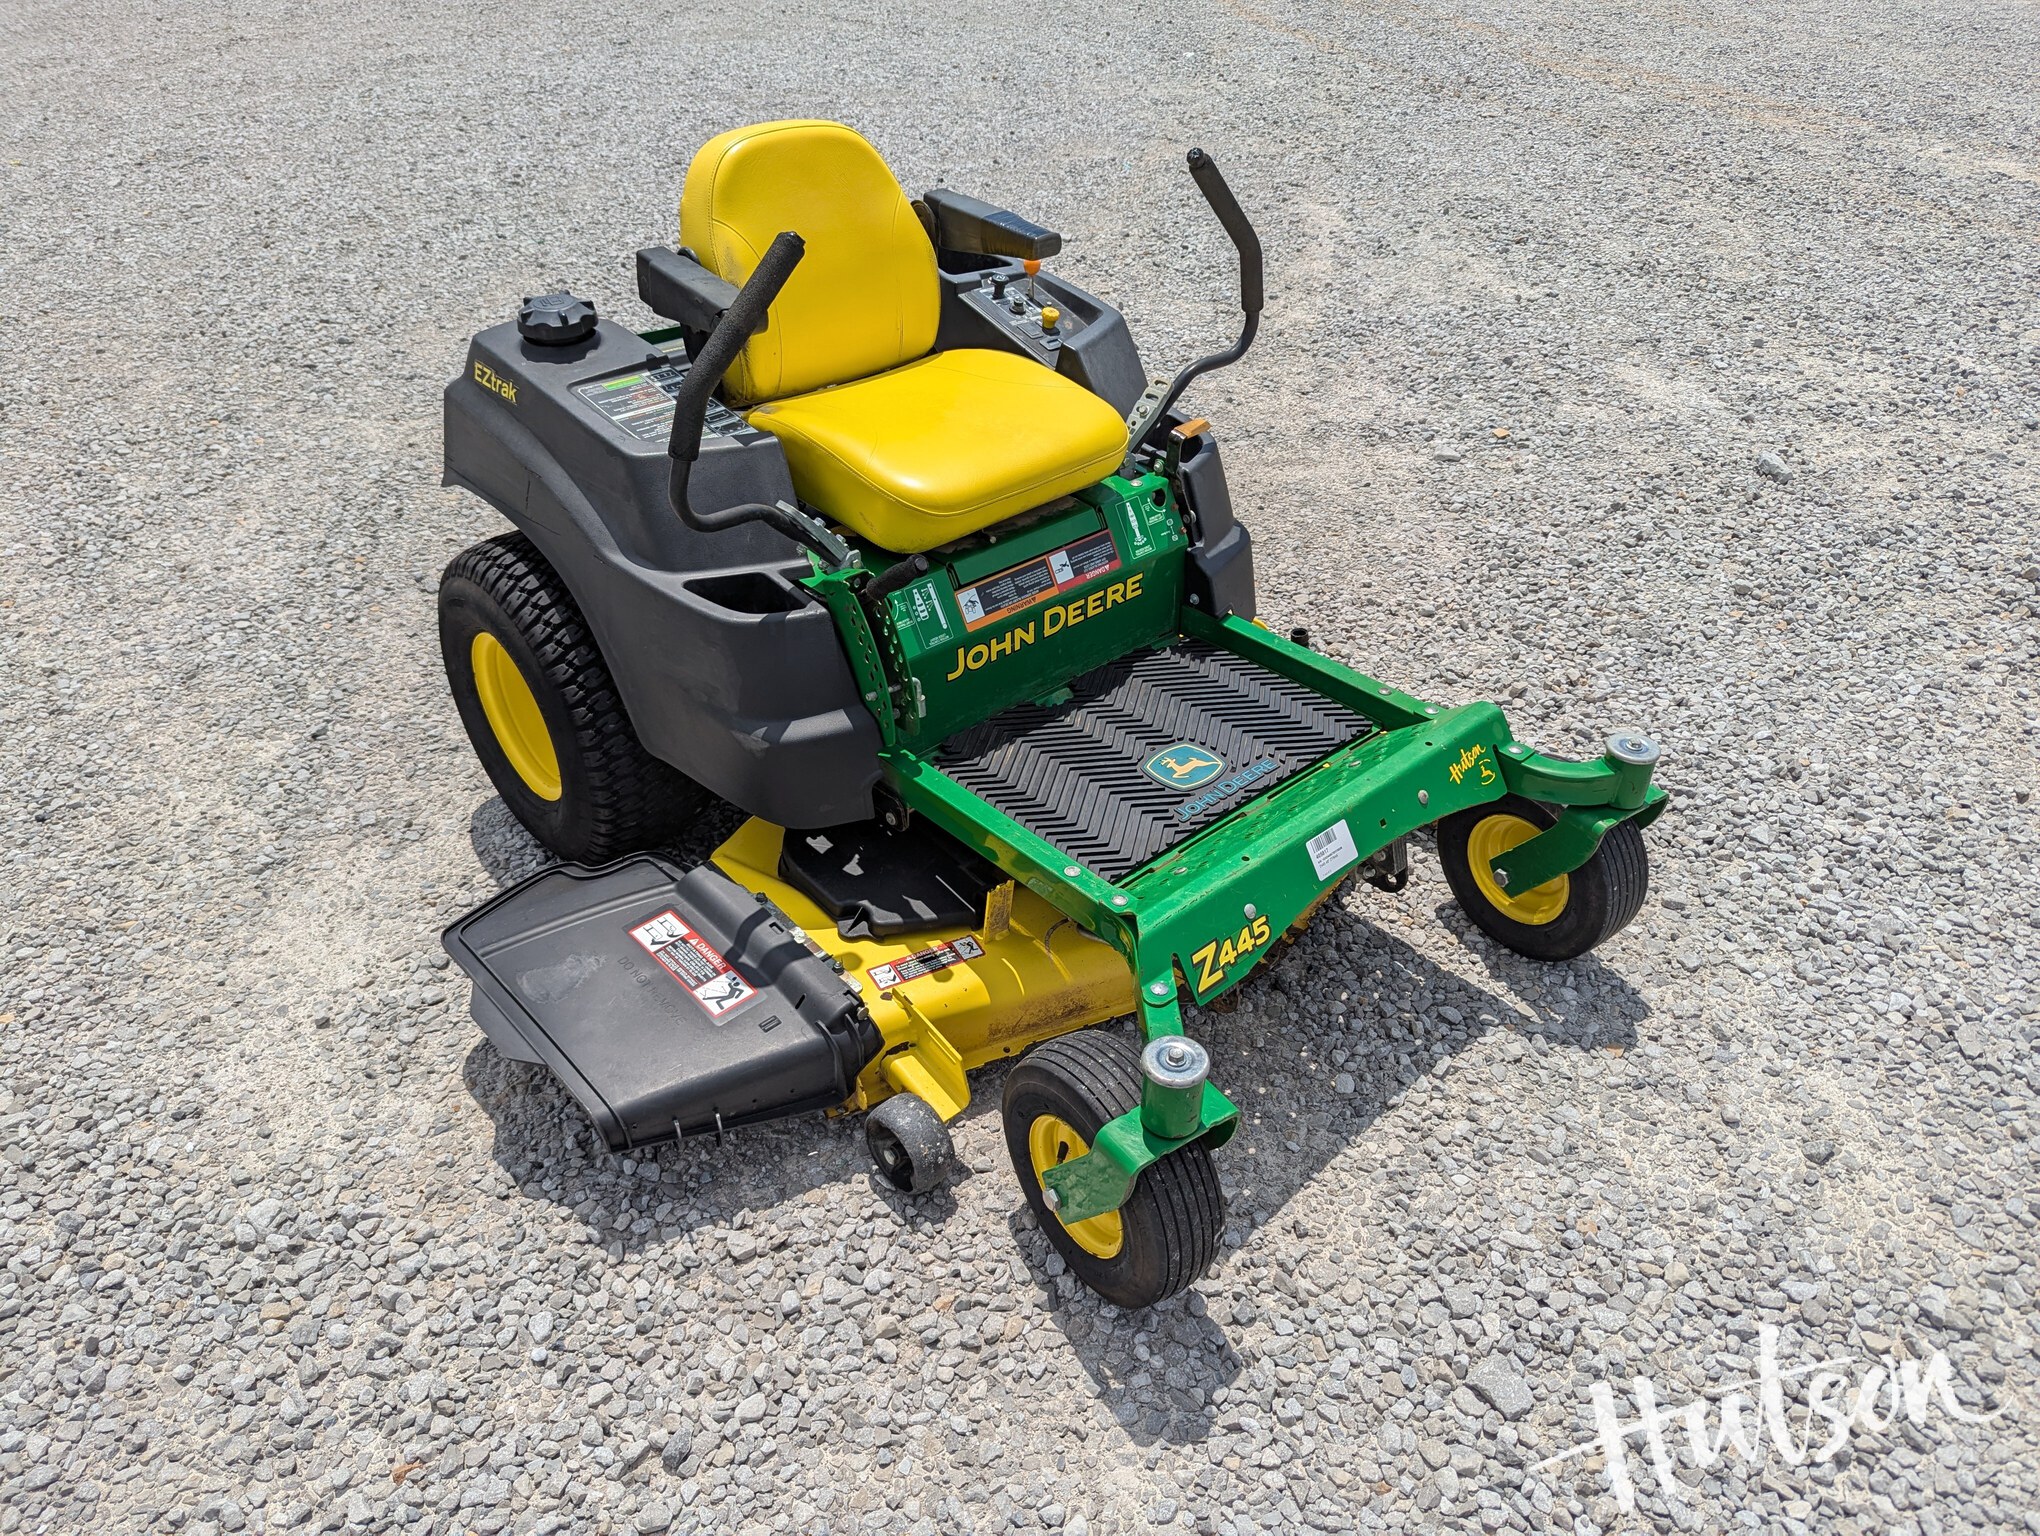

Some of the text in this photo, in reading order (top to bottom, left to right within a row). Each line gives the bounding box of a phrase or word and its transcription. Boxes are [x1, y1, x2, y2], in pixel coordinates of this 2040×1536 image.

[474, 361, 518, 403] EZtrak
[1006, 597, 1033, 614] WARNING
[946, 620, 1036, 682] JOHN
[1043, 572, 1145, 638] DEERE
[1449, 744, 1487, 784] Hutson
[1175, 758, 1279, 822] JOHN DEERE
[695, 942, 727, 970] DANGER
[1191, 914, 1271, 994] Z445
